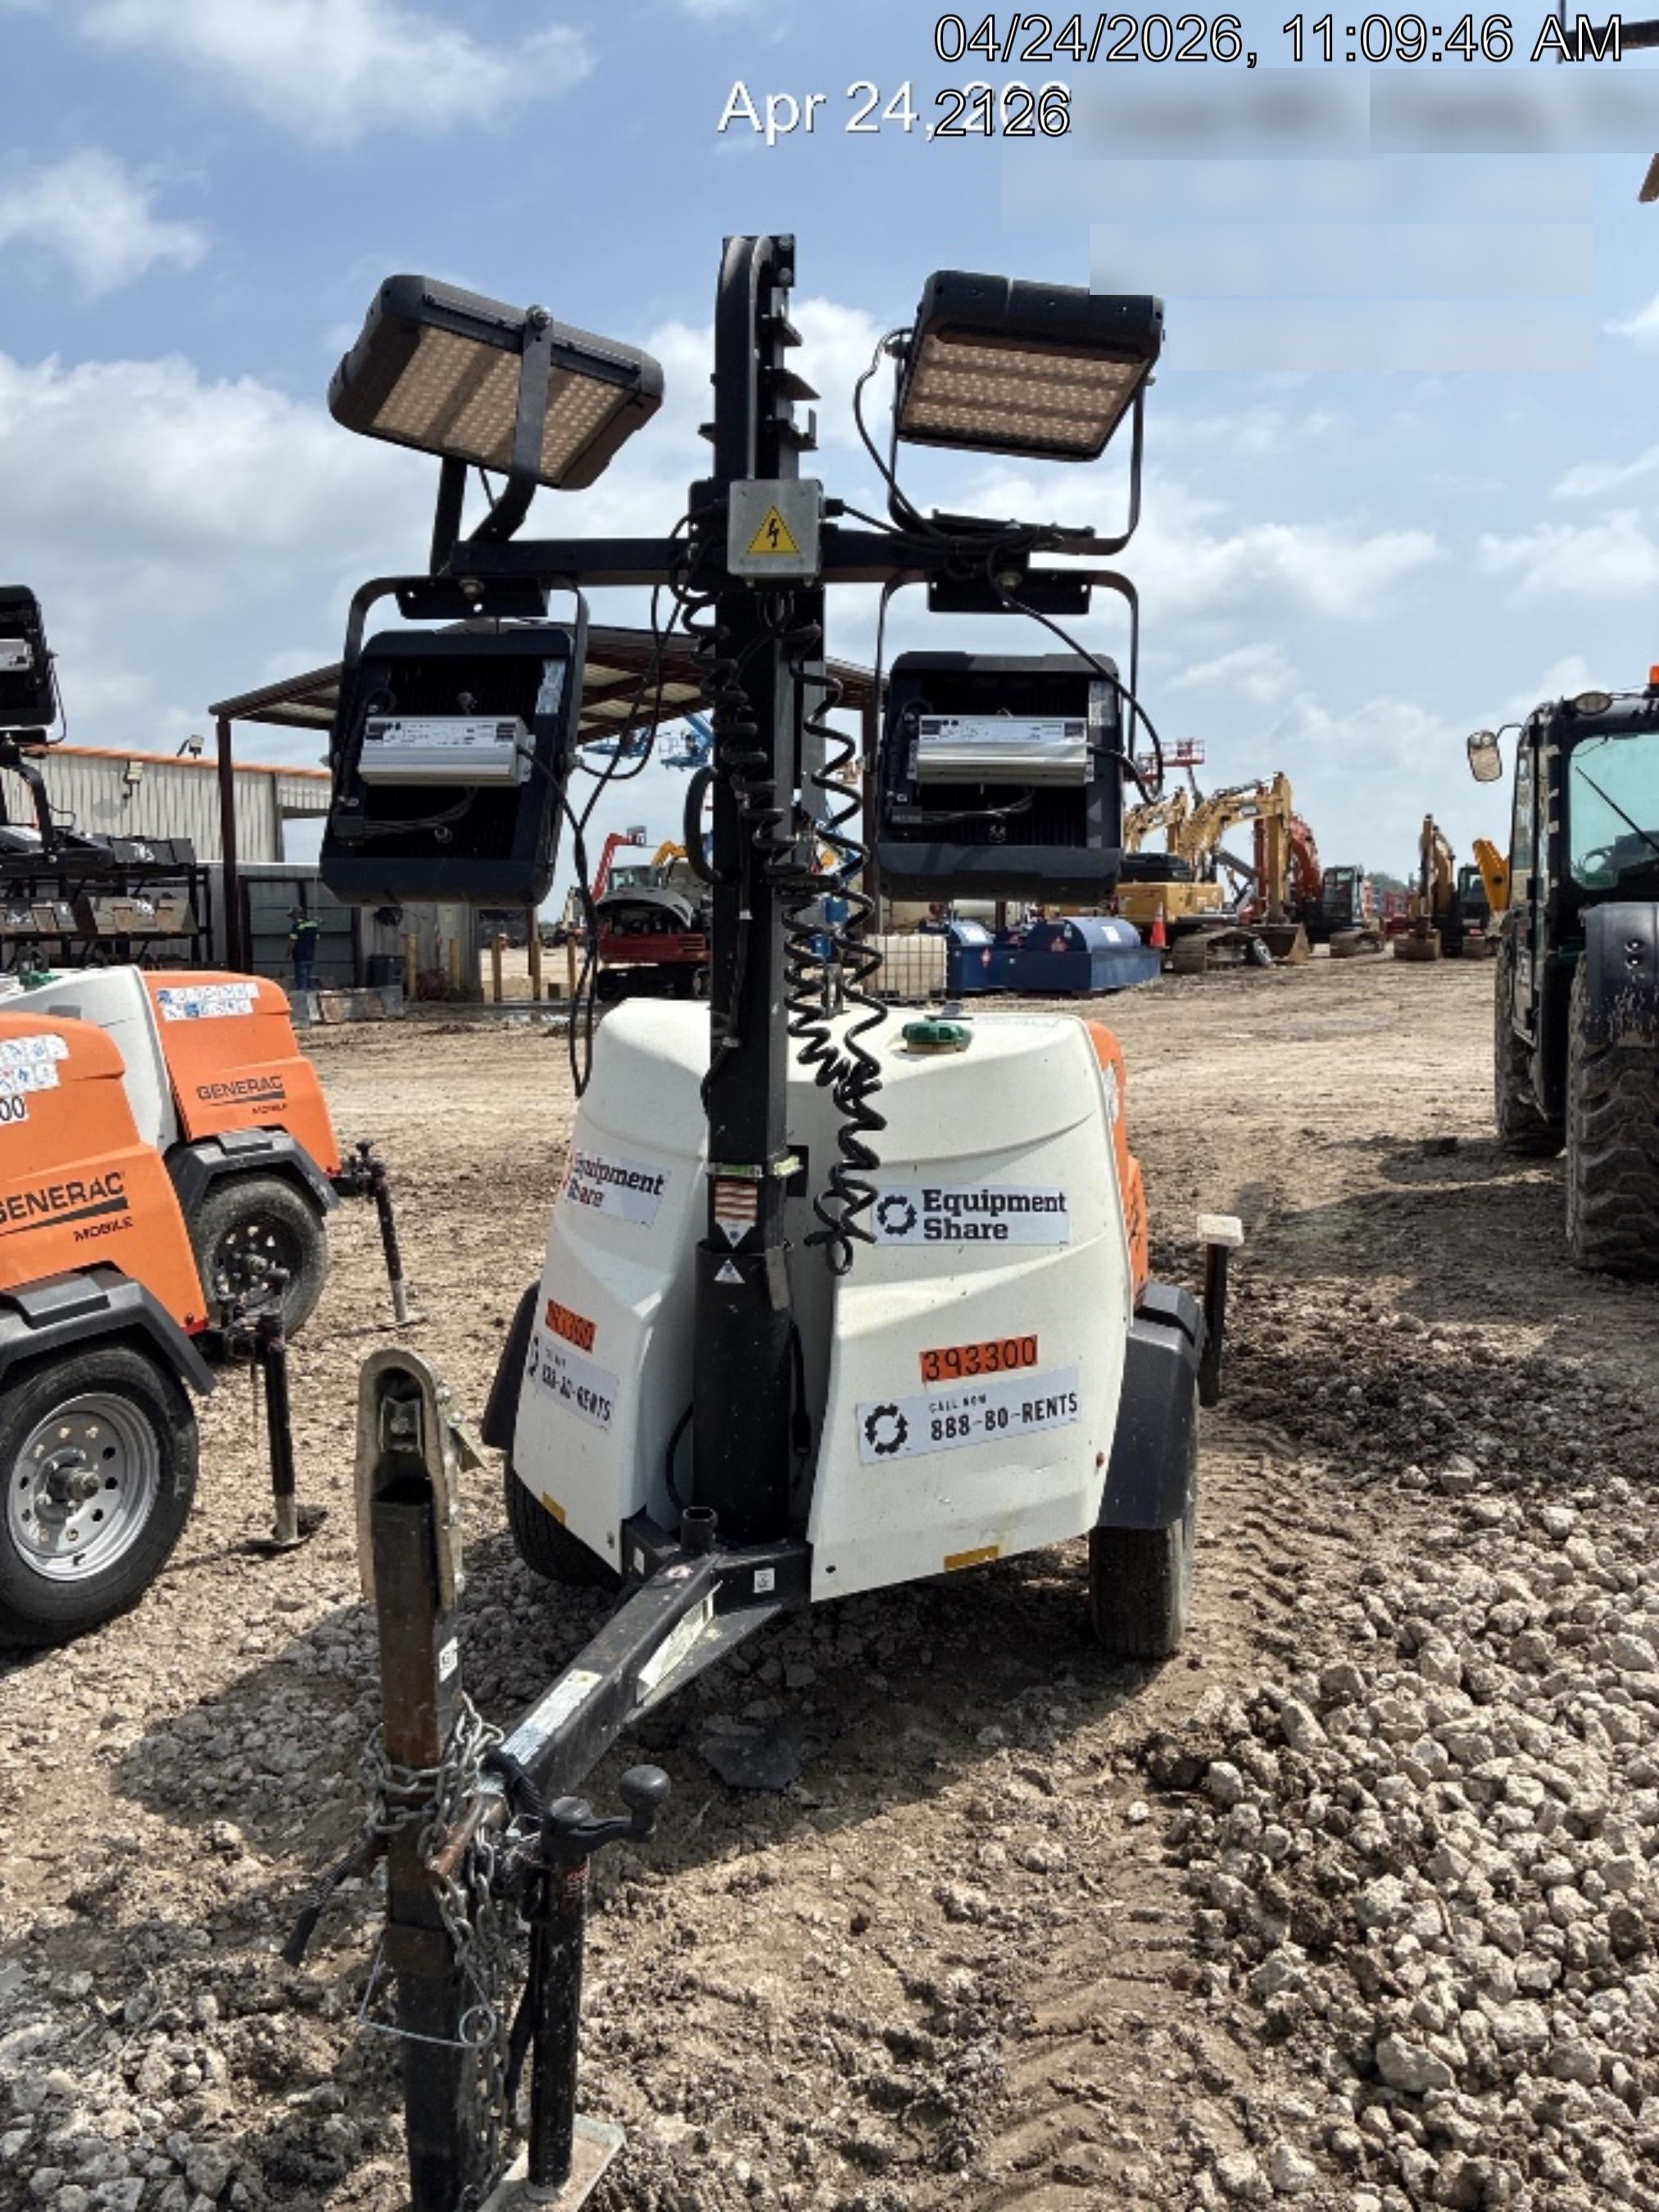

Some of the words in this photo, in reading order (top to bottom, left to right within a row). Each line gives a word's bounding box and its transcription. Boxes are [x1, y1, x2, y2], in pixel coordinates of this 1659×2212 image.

[922, 1189, 1067, 1217] Equipment
[923, 1217, 1009, 1240] Share
[923, 1336, 1036, 1381] 393300
[929, 1398, 958, 1413] CALL
[931, 1392, 1078, 1441] 888-80-RENTS
